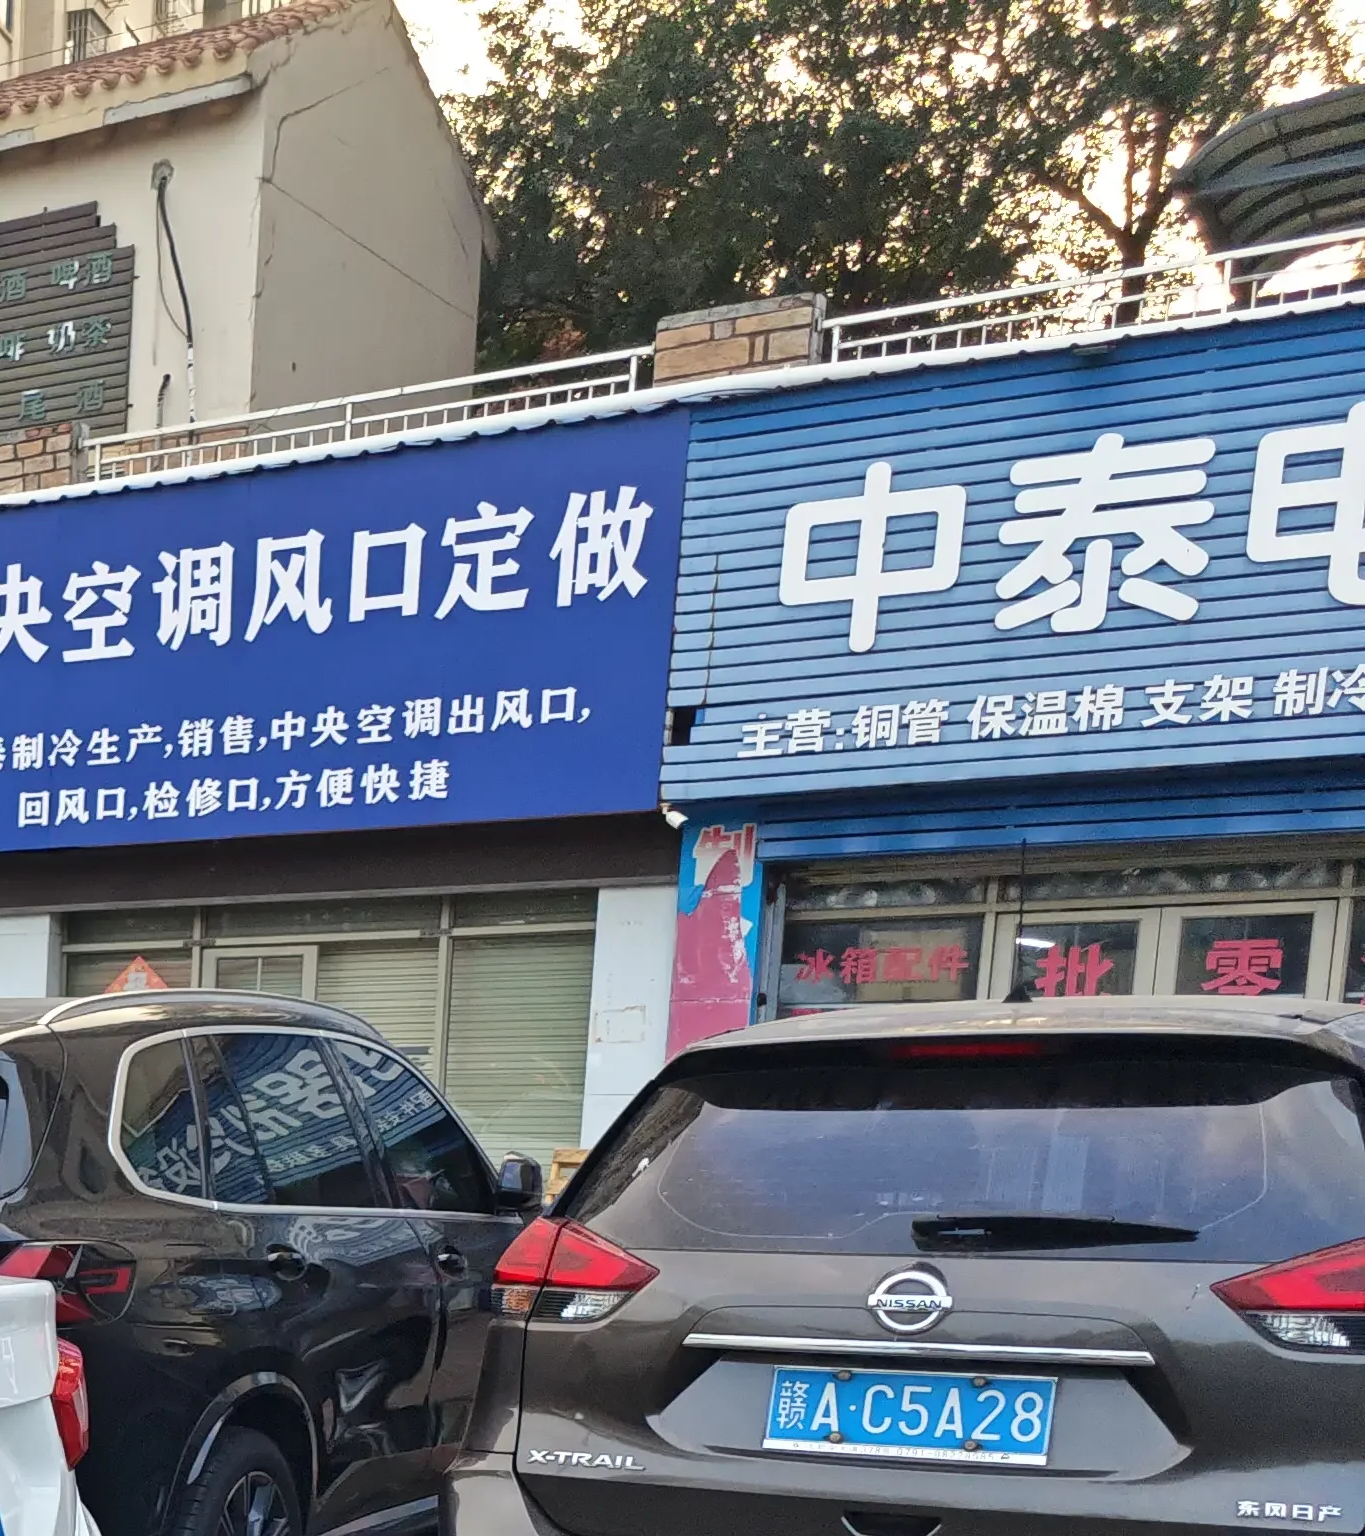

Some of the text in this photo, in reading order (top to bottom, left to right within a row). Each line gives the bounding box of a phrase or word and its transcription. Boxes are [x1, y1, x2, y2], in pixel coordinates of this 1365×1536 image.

[51, 251, 114, 290] 啤酒
[46, 315, 112, 354] 奶茶
[968, 684, 1125, 741] 保温棉
[1141, 675, 1254, 727] 支架
[794, 945, 971, 985] 冰箱配件
[1199, 939, 1286, 997] 零
[876, 1297, 942, 1310] NISSAN
[776, 1379, 1044, 1442] 赣A·C5A28
[528, 1449, 647, 1471] X-TRAIL
[1236, 1500, 1342, 1522] 东风日产
